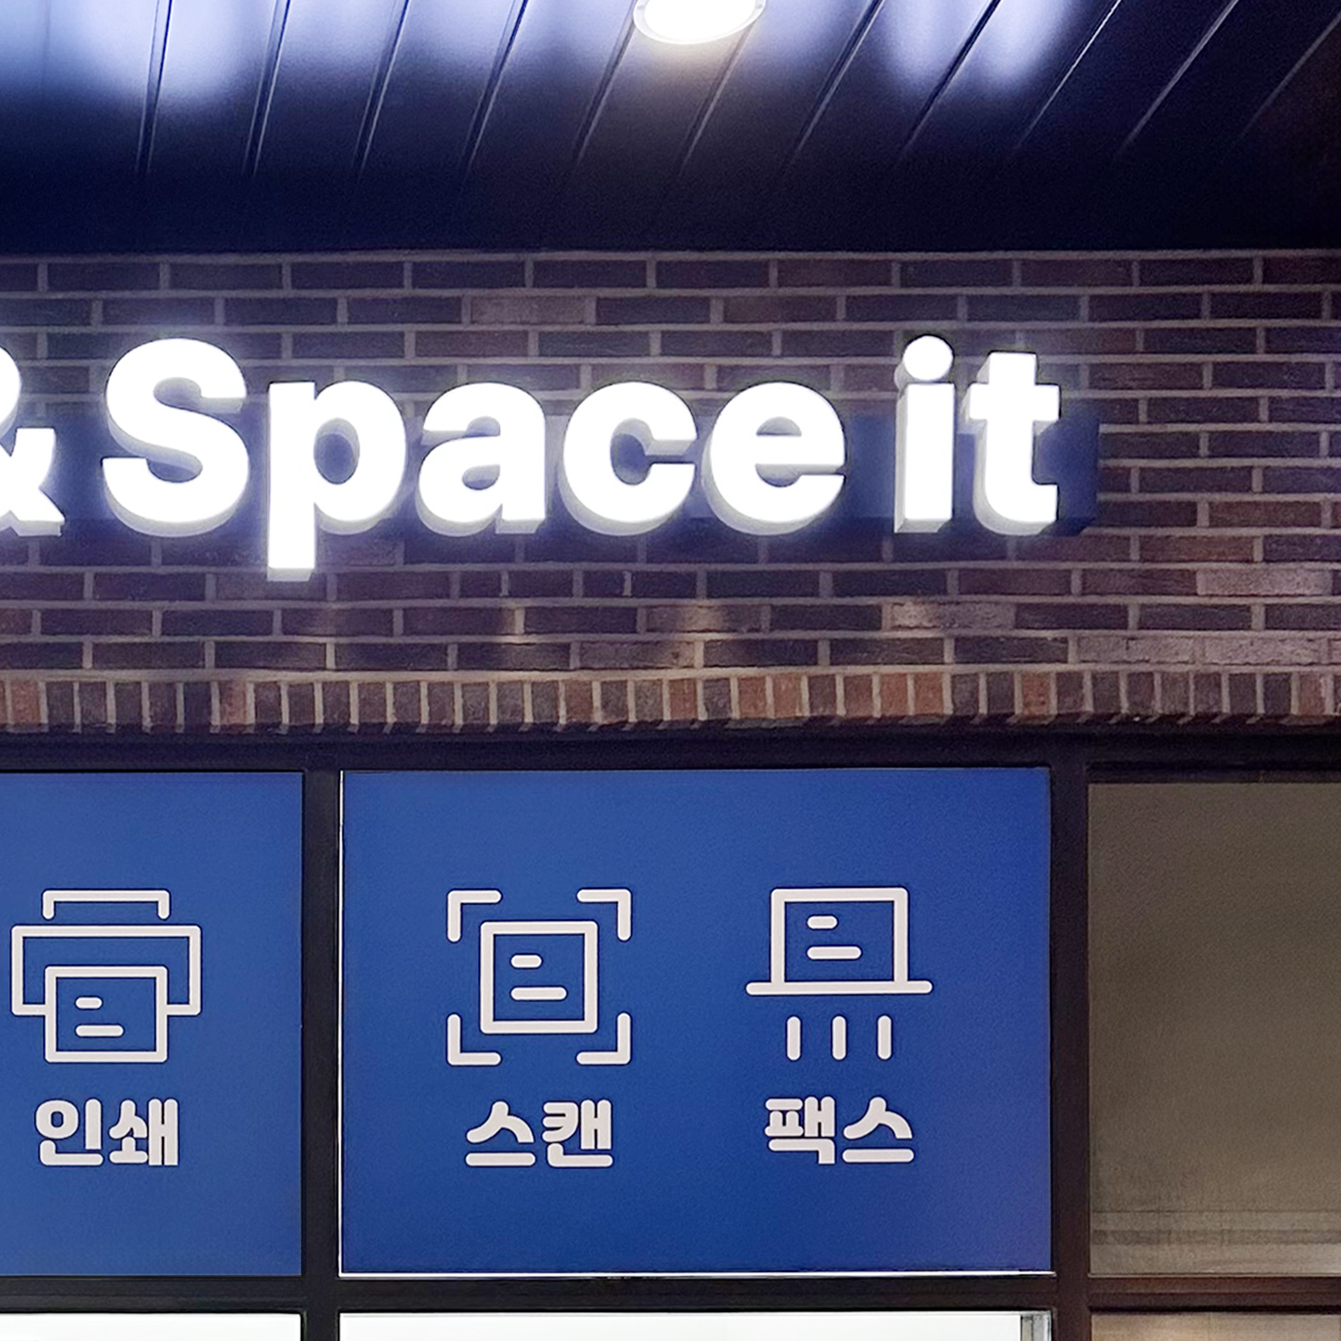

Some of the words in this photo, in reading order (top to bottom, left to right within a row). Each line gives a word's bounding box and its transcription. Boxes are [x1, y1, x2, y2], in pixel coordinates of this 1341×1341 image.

[100, 335, 847, 582] Space
[893, 334, 1060, 535] it
[34, 1098, 179, 1167] 인쇄
[465, 1099, 614, 1168] 스캔
[764, 1096, 914, 1165] 팩스
